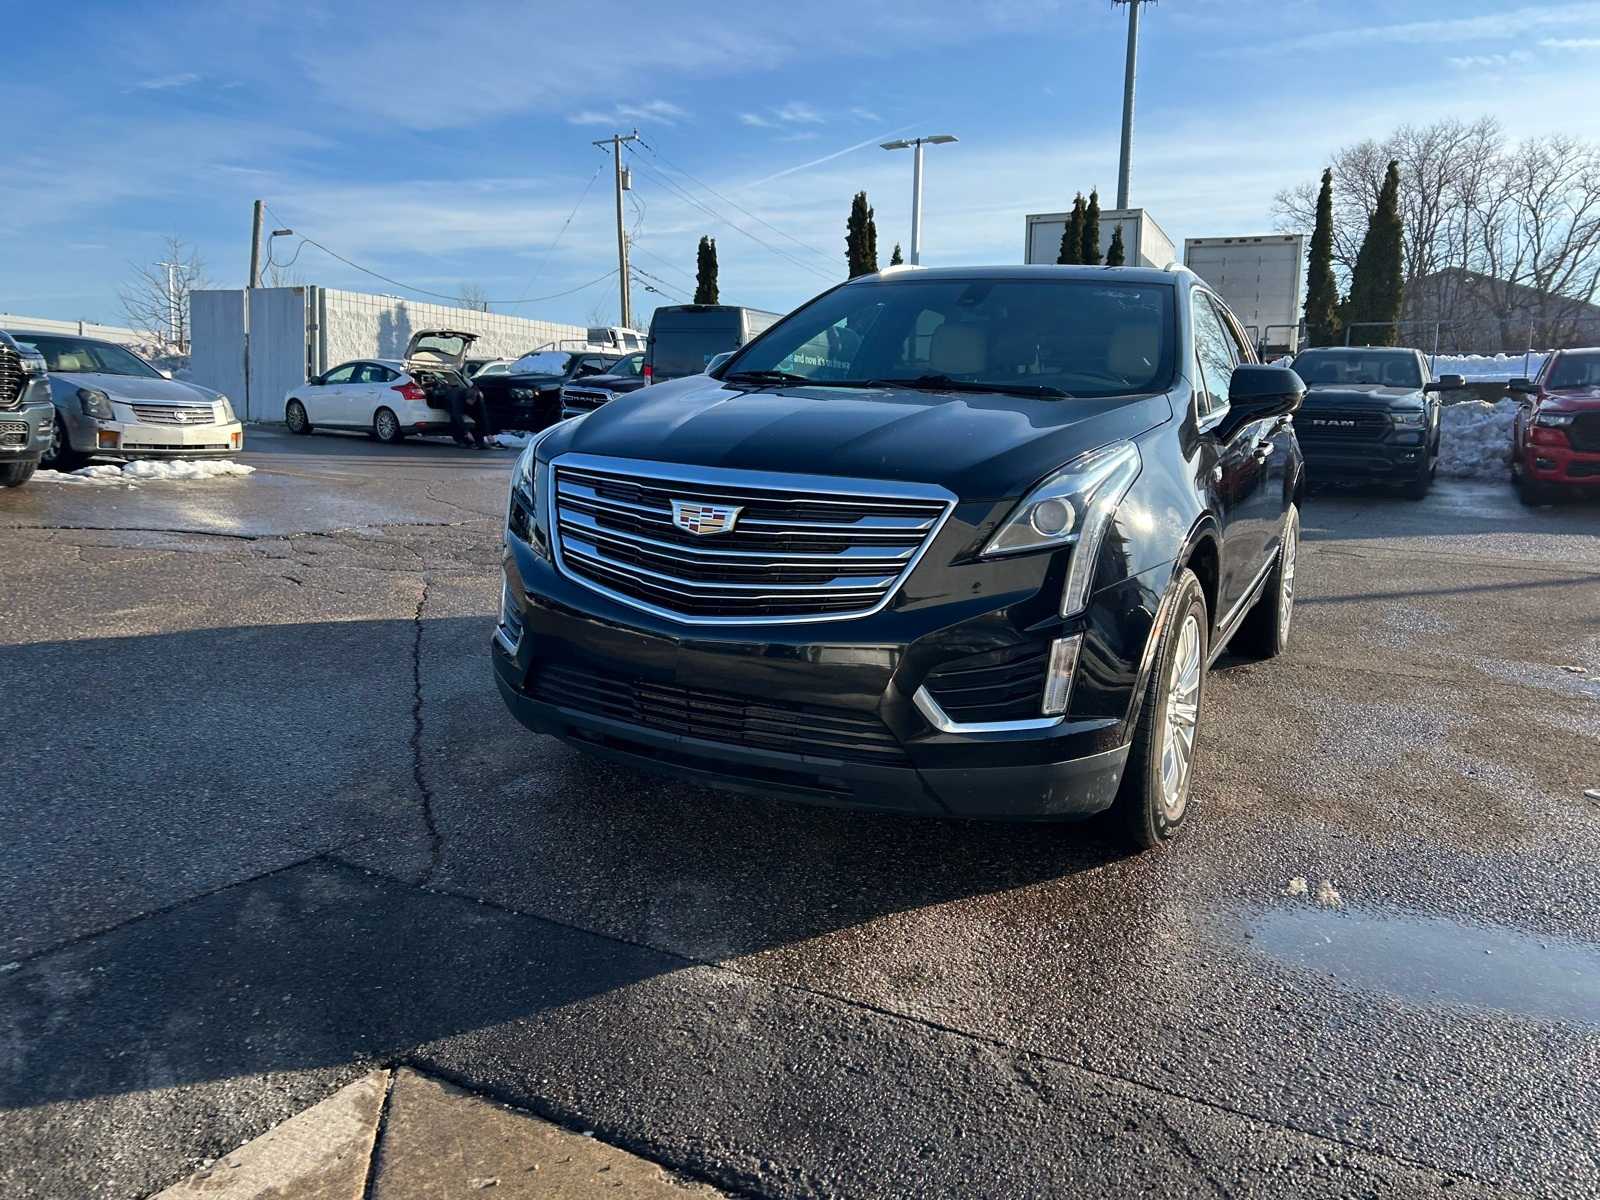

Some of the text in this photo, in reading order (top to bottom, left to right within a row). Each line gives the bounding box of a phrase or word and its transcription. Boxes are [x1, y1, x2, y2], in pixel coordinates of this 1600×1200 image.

[794, 353, 804, 364] and
[805, 356, 816, 365] now
[1312, 419, 1355, 427] RAM
